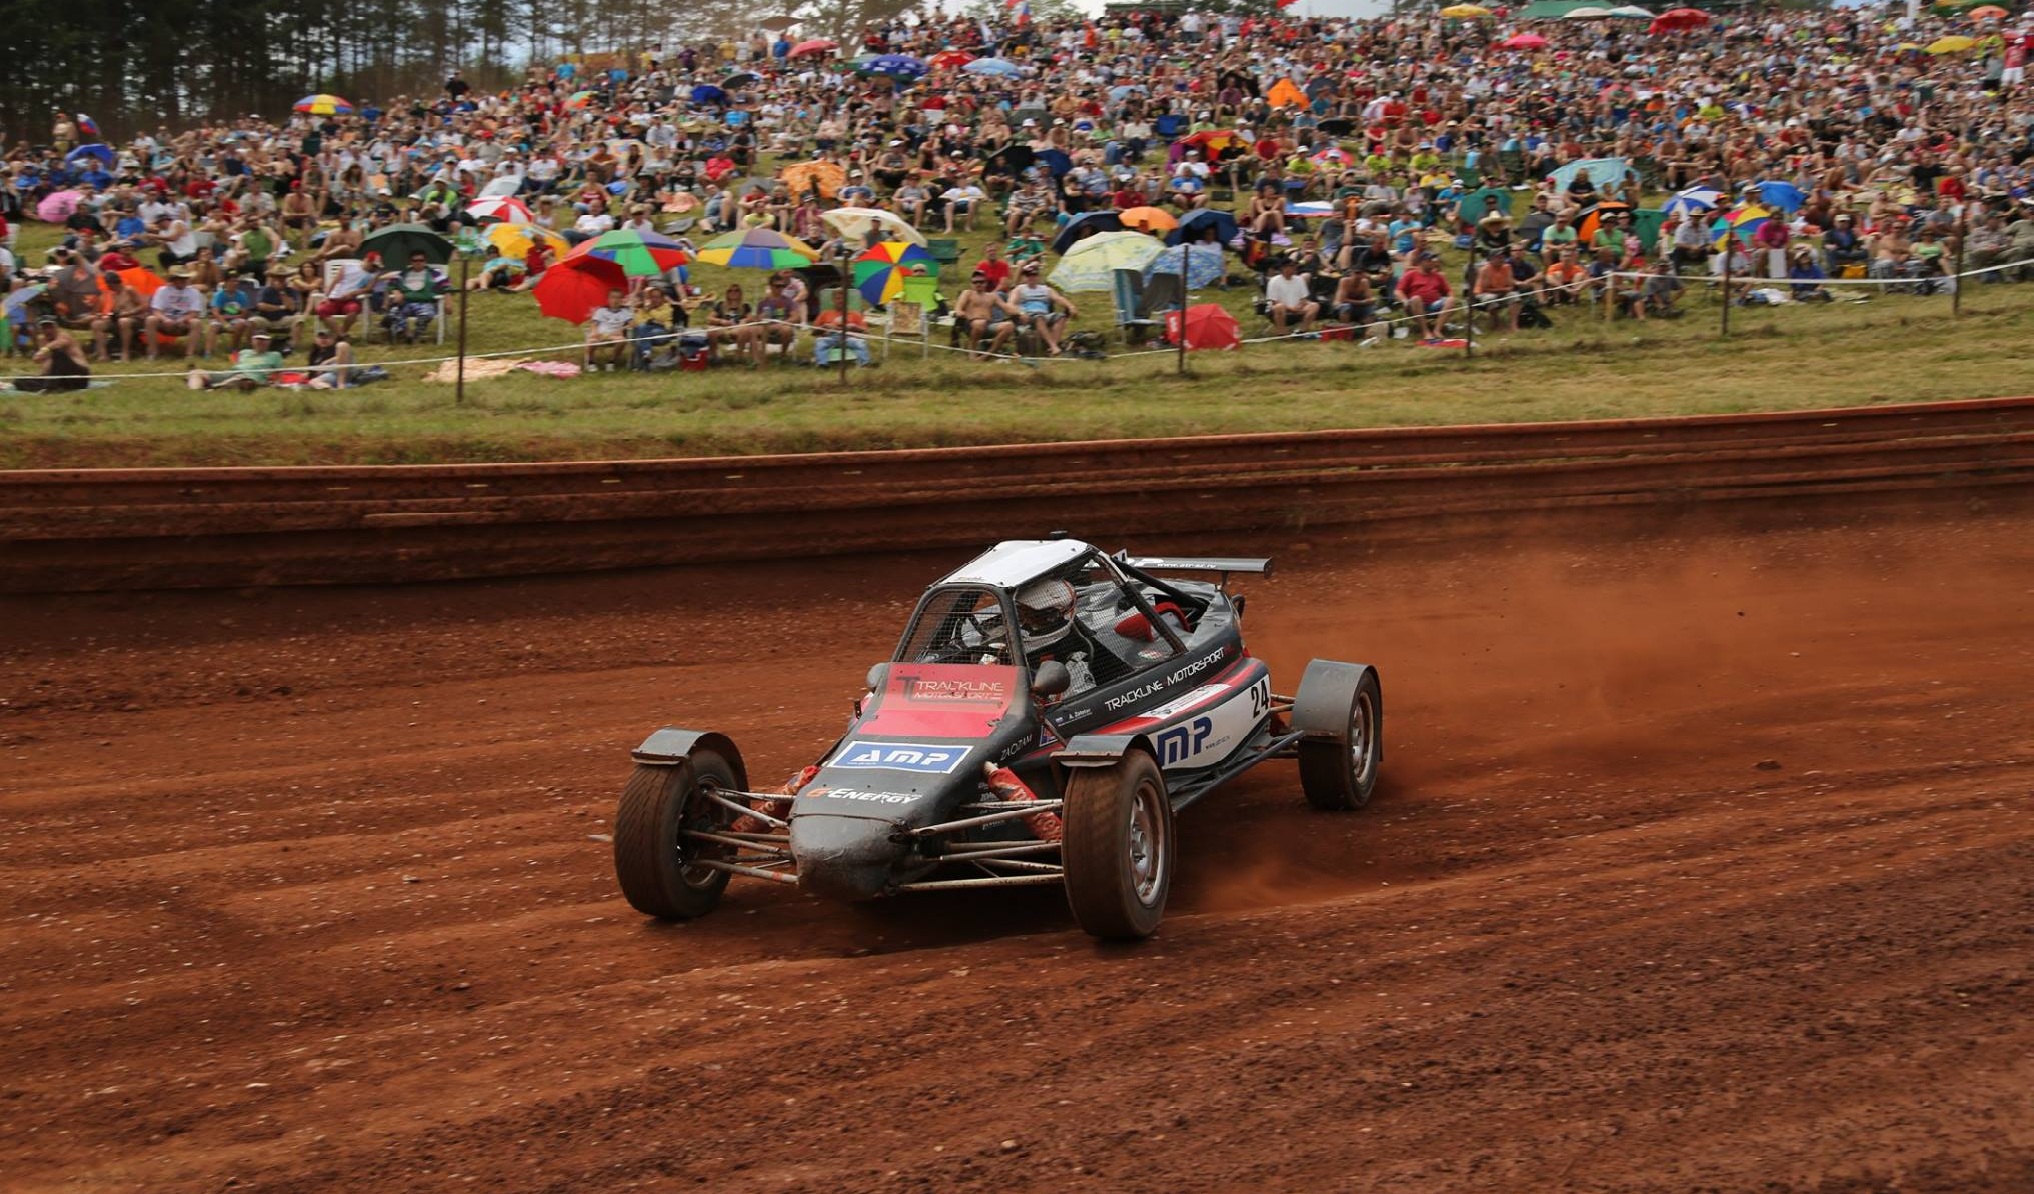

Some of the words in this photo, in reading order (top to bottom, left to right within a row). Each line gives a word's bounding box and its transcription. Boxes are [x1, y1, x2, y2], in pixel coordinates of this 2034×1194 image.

[917, 680, 1004, 692] TRACKLINE
[1104, 680, 1164, 712] TRACKLINE
[1166, 646, 1225, 686] MOTORSPORT
[1251, 679, 1269, 719] 24
[1157, 716, 1212, 770] MP
